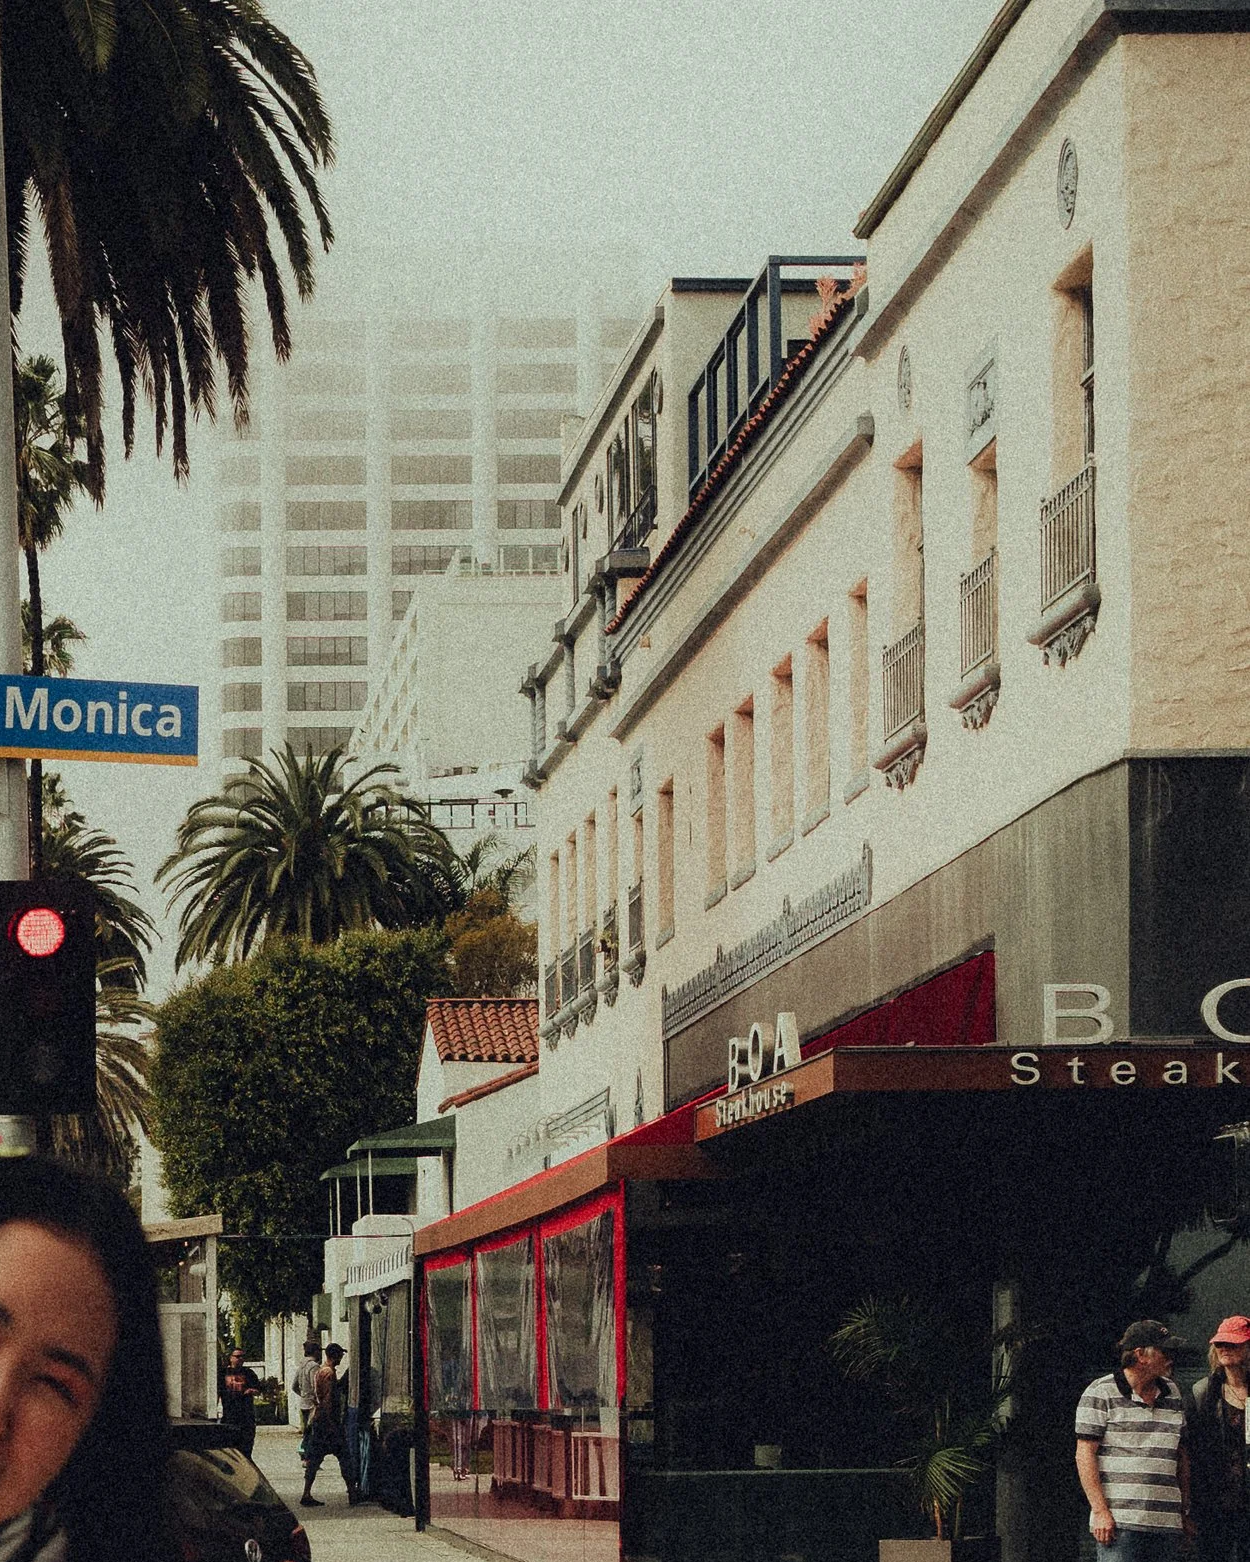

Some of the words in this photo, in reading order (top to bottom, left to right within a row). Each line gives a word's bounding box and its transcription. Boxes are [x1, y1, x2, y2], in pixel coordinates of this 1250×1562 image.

[4, 685, 183, 738] Monica
[728, 1011, 802, 1095] BOA
[1010, 1051, 1242, 1086] Steak
[714, 1080, 789, 1128] Steakhouse
